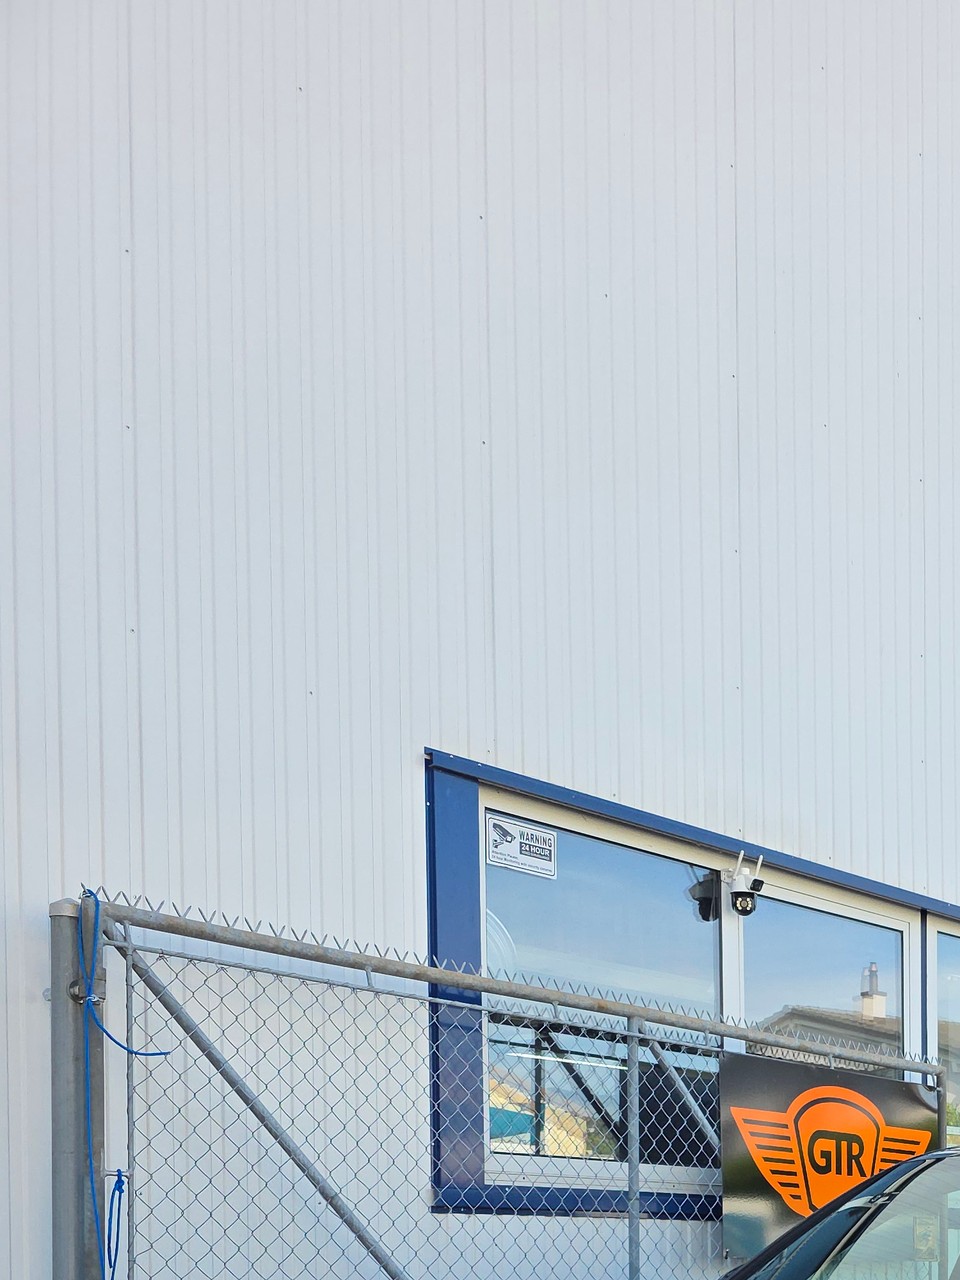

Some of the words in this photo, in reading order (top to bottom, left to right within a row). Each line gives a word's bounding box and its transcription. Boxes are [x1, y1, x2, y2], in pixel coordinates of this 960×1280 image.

[519, 830, 552, 848] WARNING
[521, 843, 530, 851] 24
[530, 845, 550, 857] HOUR
[808, 1129, 867, 1178] GTR
